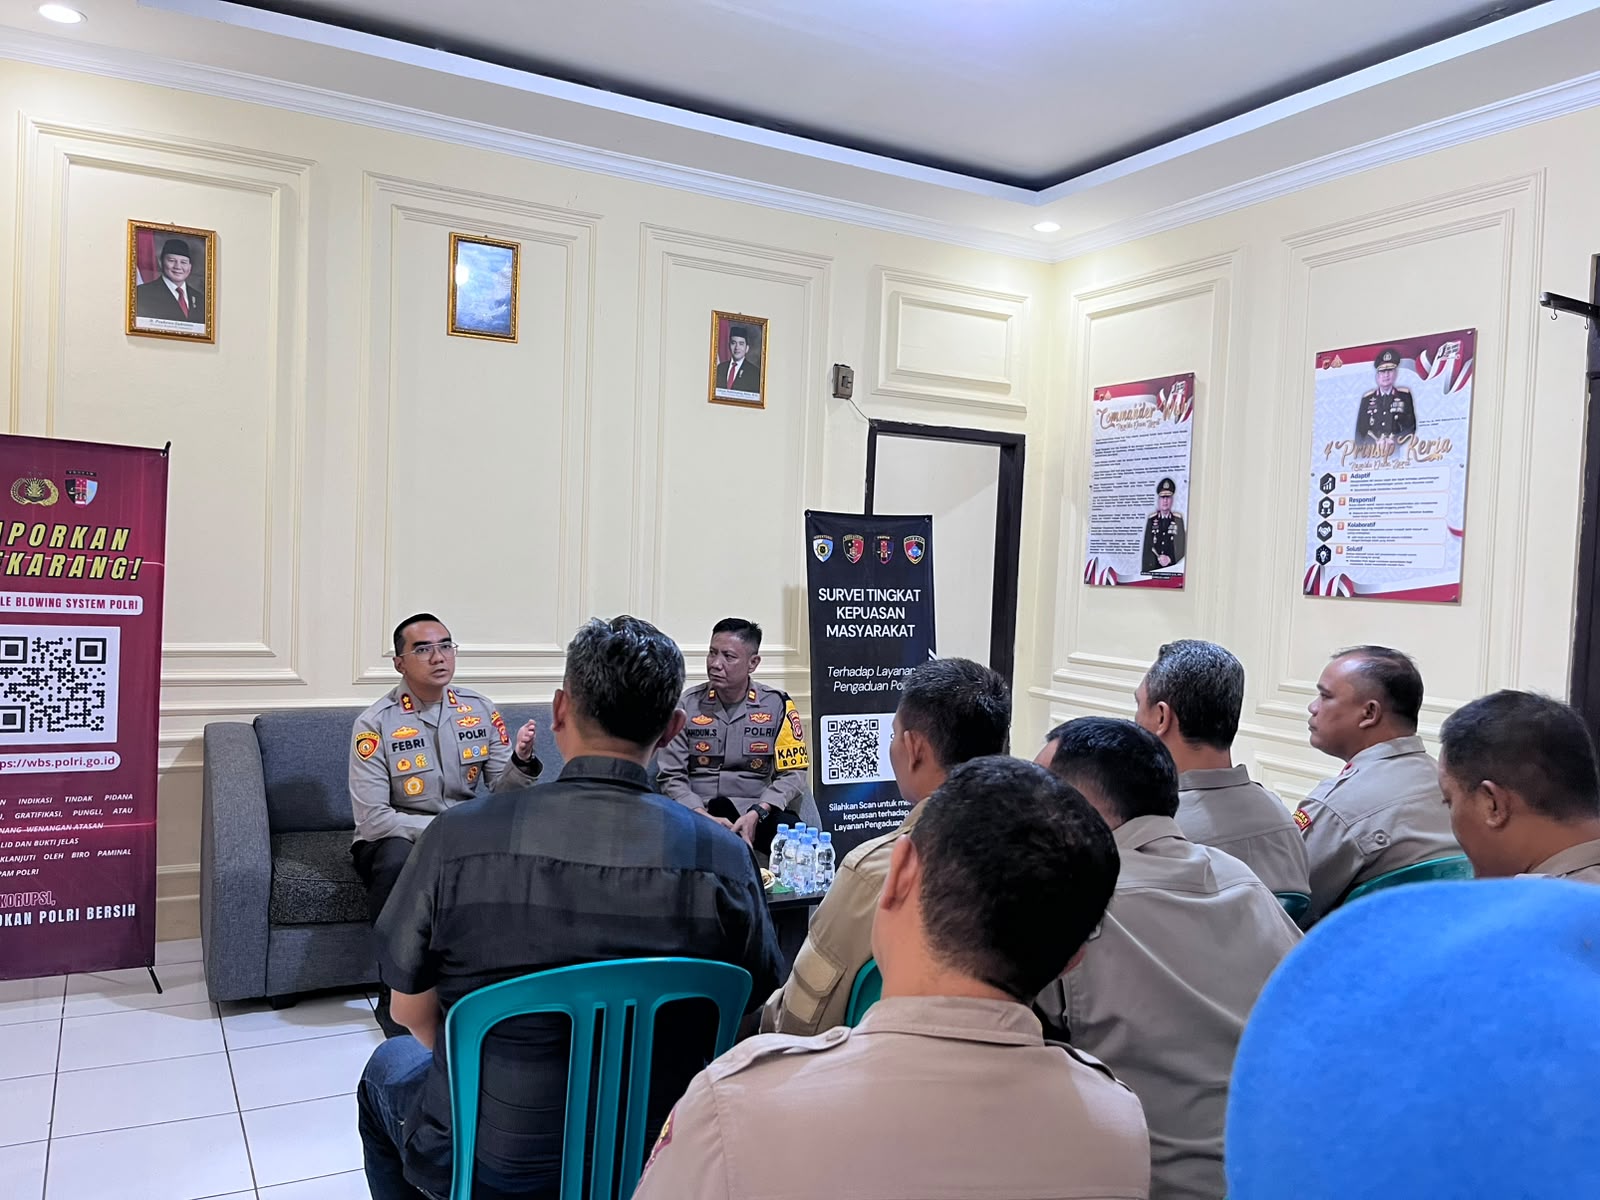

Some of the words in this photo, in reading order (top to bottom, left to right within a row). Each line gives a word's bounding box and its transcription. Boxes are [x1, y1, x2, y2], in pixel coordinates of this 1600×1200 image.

[1350, 472, 1371, 480] Adaptif
[1349, 496, 1376, 504] Responsif
[818, 587, 864, 601] SURVEI
[866, 588, 921, 602] TINGKAT
[16, 597, 61, 608] BLOWING
[66, 598, 105, 609] SYSTEM
[110, 599, 138, 610] POLRI
[836, 606, 905, 620] KEPUASAN
[826, 624, 915, 638] MASYARAKAT
[827, 666, 874, 679] Terhadap
[833, 680, 889, 695] Pengaduan
[458, 729, 487, 741] POLRI
[744, 727, 775, 737] POLRI
[391, 738, 425, 752] FEBRI
[18, 797, 53, 805] INDIKASI
[65, 795, 93, 803] TINDAK
[104, 793, 133, 801] PIDANA
[829, 802, 858, 811] Silahkan
[859, 801, 877, 809] Scan
[877, 799, 897, 807] untuk
[15, 810, 63, 819] GRATIFIKASI,
[73, 808, 104, 816] PUNGLI,
[112, 807, 133, 815] ATAU
[843, 812, 877, 821] kepuasan
[26, 824, 72, 832] WENANGAN
[73, 822, 104, 830] ATASAN
[834, 823, 864, 832] Layanan
[15, 840, 32, 848] DAN
[34, 839, 56, 847] BUKTI
[57, 837, 79, 846] JELAS
[43, 852, 64, 860] OLEH
[71, 851, 90, 859] BIRO
[97, 848, 132, 857] PAMINAL
[16, 868, 39, 876] POLRI
[39, 908, 80, 924] POLRI
[86, 903, 136, 920] BERSIH
